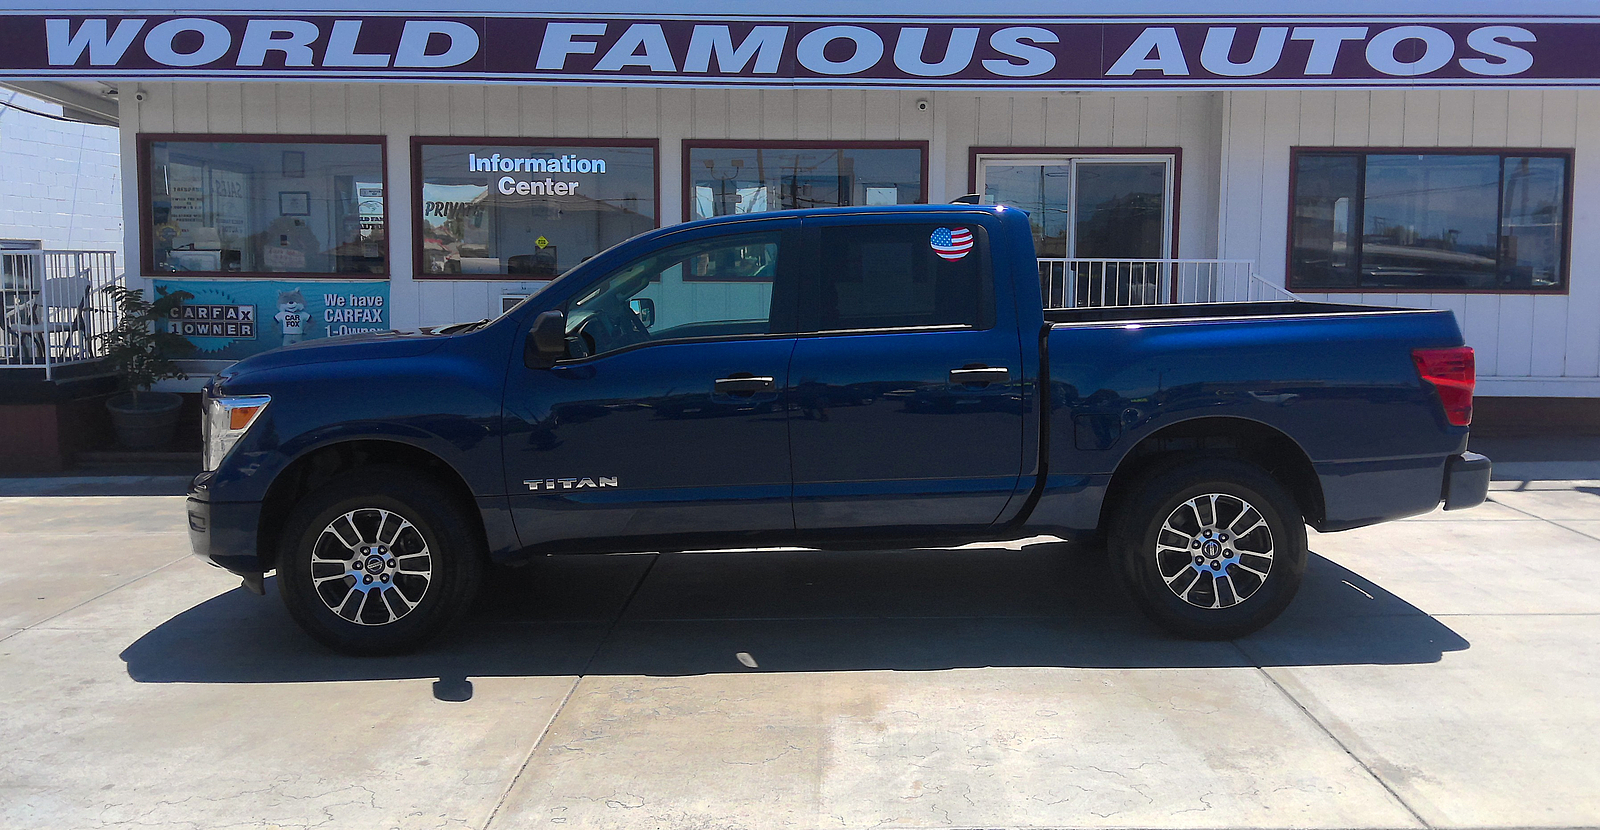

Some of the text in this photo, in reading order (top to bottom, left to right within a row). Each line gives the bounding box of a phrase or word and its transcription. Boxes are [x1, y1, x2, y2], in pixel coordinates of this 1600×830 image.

[45, 17, 1538, 77] WORLD FAMOUS AUTOS
[468, 153, 607, 174] Information
[498, 176, 580, 196] Center
[323, 293, 384, 307] We have
[169, 307, 251, 321] CARFAX
[324, 308, 383, 323] CARFAX
[523, 476, 618, 491] TITAN
